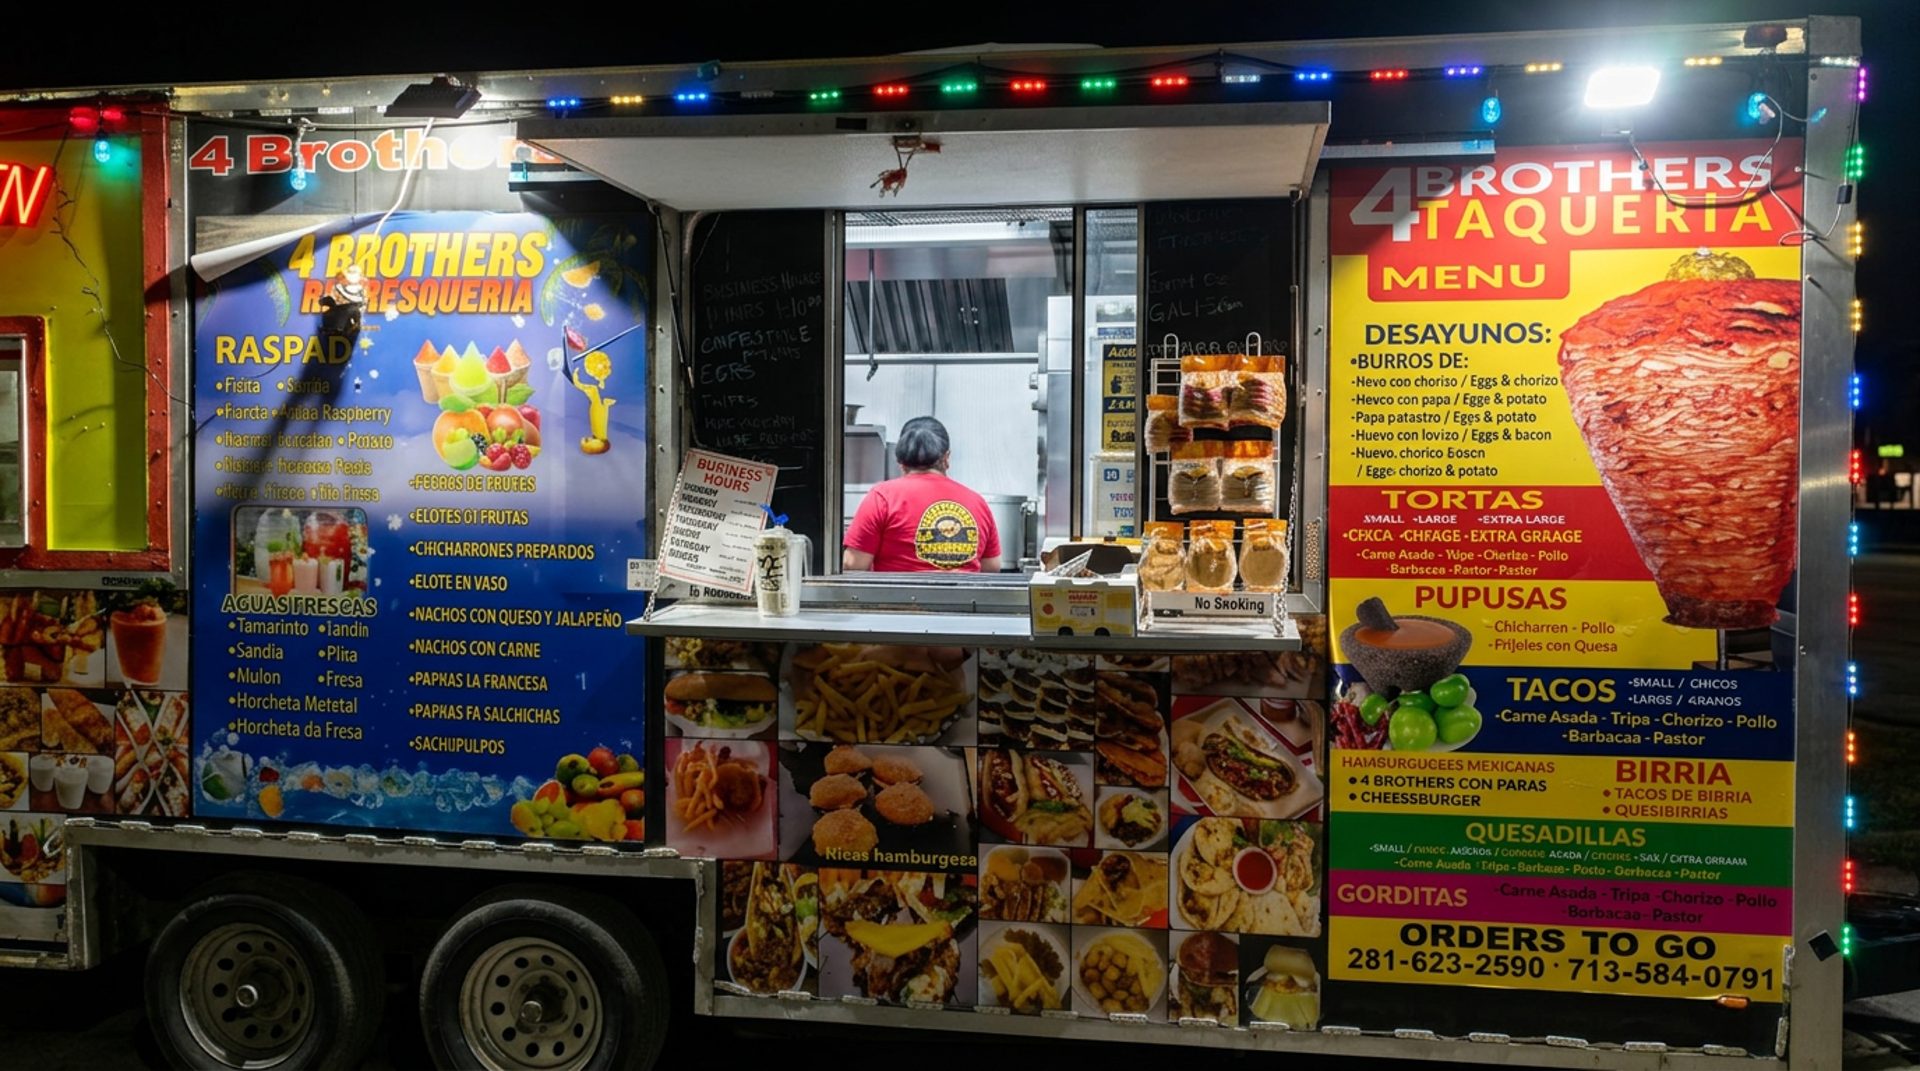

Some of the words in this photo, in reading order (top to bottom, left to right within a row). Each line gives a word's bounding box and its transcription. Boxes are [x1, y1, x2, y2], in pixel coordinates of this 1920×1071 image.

[189, 135, 234, 176] 4
[1349, 166, 1420, 242] 4
[1416, 154, 1774, 199] BROTHERS
[288, 233, 317, 279] 4
[325, 232, 549, 279] BROTHERS
[1382, 263, 1546, 290] MENU
[301, 279, 534, 316] RRESQUERIA
[1365, 322, 1552, 345] DESAYUNOS:
[1358, 353, 1433, 369] BURROS
[1439, 352, 1469, 368] DE:
[1414, 375, 1458, 388] choriso
[1513, 373, 1558, 387] chorizo
[1397, 395, 1419, 406] con
[1422, 395, 1451, 408] papa
[1506, 393, 1547, 407] potato
[1496, 411, 1537, 426] potato
[1397, 431, 1419, 441] con
[1515, 428, 1552, 441] bacon
[1398, 464, 1443, 477] chorizo
[1458, 465, 1498, 479] potato
[704, 473, 751, 493] HOURS
[1381, 490, 1545, 510] TORTAS
[480, 509, 529, 525] FRUTAS
[1470, 530, 1518, 543] EXTRA
[516, 543, 595, 560] PREPARDOS
[415, 574, 453, 590] ELOTE
[455, 575, 471, 590] EN
[474, 575, 508, 592] VASO
[1195, 597, 1211, 609] No
[1415, 585, 1568, 610] PUPUSAS
[236, 617, 309, 636] Tamarinto
[415, 606, 467, 623] NACHOS
[469, 607, 497, 624] CON
[499, 608, 542, 627] QUESO
[544, 610, 554, 626] Y
[555, 609, 622, 628] JALAPEÑO
[1581, 621, 1616, 634] Pollo
[237, 641, 284, 660] Sandia
[415, 639, 467, 655] NACHOS
[469, 640, 496, 656] CON
[499, 641, 541, 658] CARNE
[236, 667, 281, 685] Mulon
[326, 670, 363, 688] Fresa
[466, 672, 480, 689] LA
[483, 673, 548, 692] FRANCESA
[1506, 676, 1617, 703] TACOS
[236, 691, 300, 712] Horcheta
[483, 706, 560, 725] SALCHICHAS
[1549, 710, 1598, 725] Asada
[236, 718, 300, 737] Horcheta
[326, 721, 363, 740] Fresa
[1652, 731, 1706, 746] Pastor
[1466, 758, 1556, 774] MEXICANAS
[1615, 759, 1734, 787] BIRRIA
[1360, 775, 1370, 787] 4
[1373, 775, 1455, 789] BROTHERS
[1457, 777, 1494, 791] CON
[1497, 778, 1548, 793] PARAS
[1360, 791, 1482, 807] CHEESSBURGER
[1615, 787, 1667, 801] TACOS
[1671, 788, 1693, 802] DE
[1614, 803, 1729, 820] QUESIBIRRIAS
[1465, 821, 1647, 848] QUESADILLAS
[1337, 882, 1469, 908] GORDITAS
[1548, 886, 1597, 900] Asada
[1610, 887, 1650, 904] Tripa
[1652, 907, 1704, 924] Pastor
[1400, 922, 1566, 954] ORDERS
[1581, 930, 1650, 958] TO
[1654, 934, 1718, 961] GO
[1347, 947, 1545, 979] 281-623-2590
[1568, 957, 1776, 992] 713-584-0791
